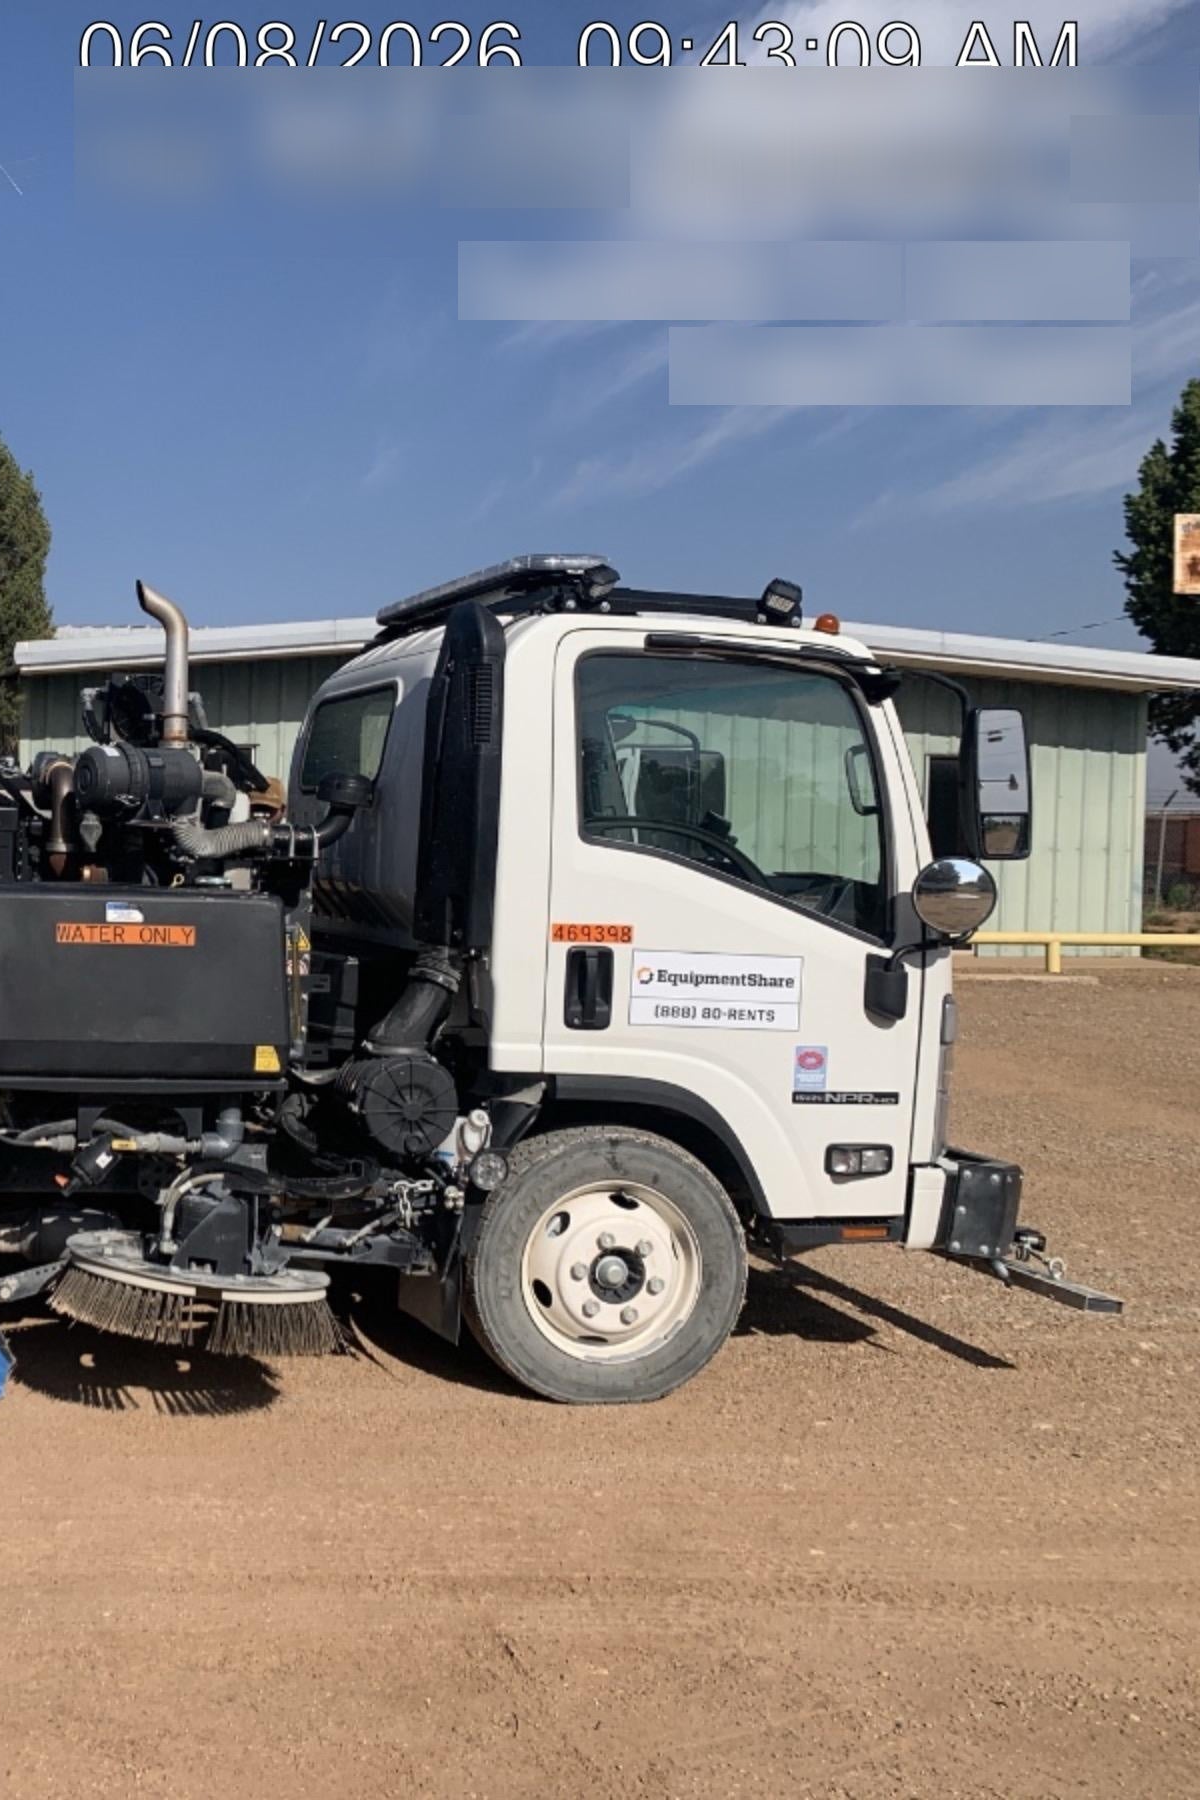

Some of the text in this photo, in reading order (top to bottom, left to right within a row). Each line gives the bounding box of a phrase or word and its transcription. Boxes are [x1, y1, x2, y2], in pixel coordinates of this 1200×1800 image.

[57, 924, 194, 945] WATER ONLY
[553, 924, 632, 943] 469398
[656, 969, 795, 989] EquipmentShare
[701, 1007, 776, 1023] 80-RENTS
